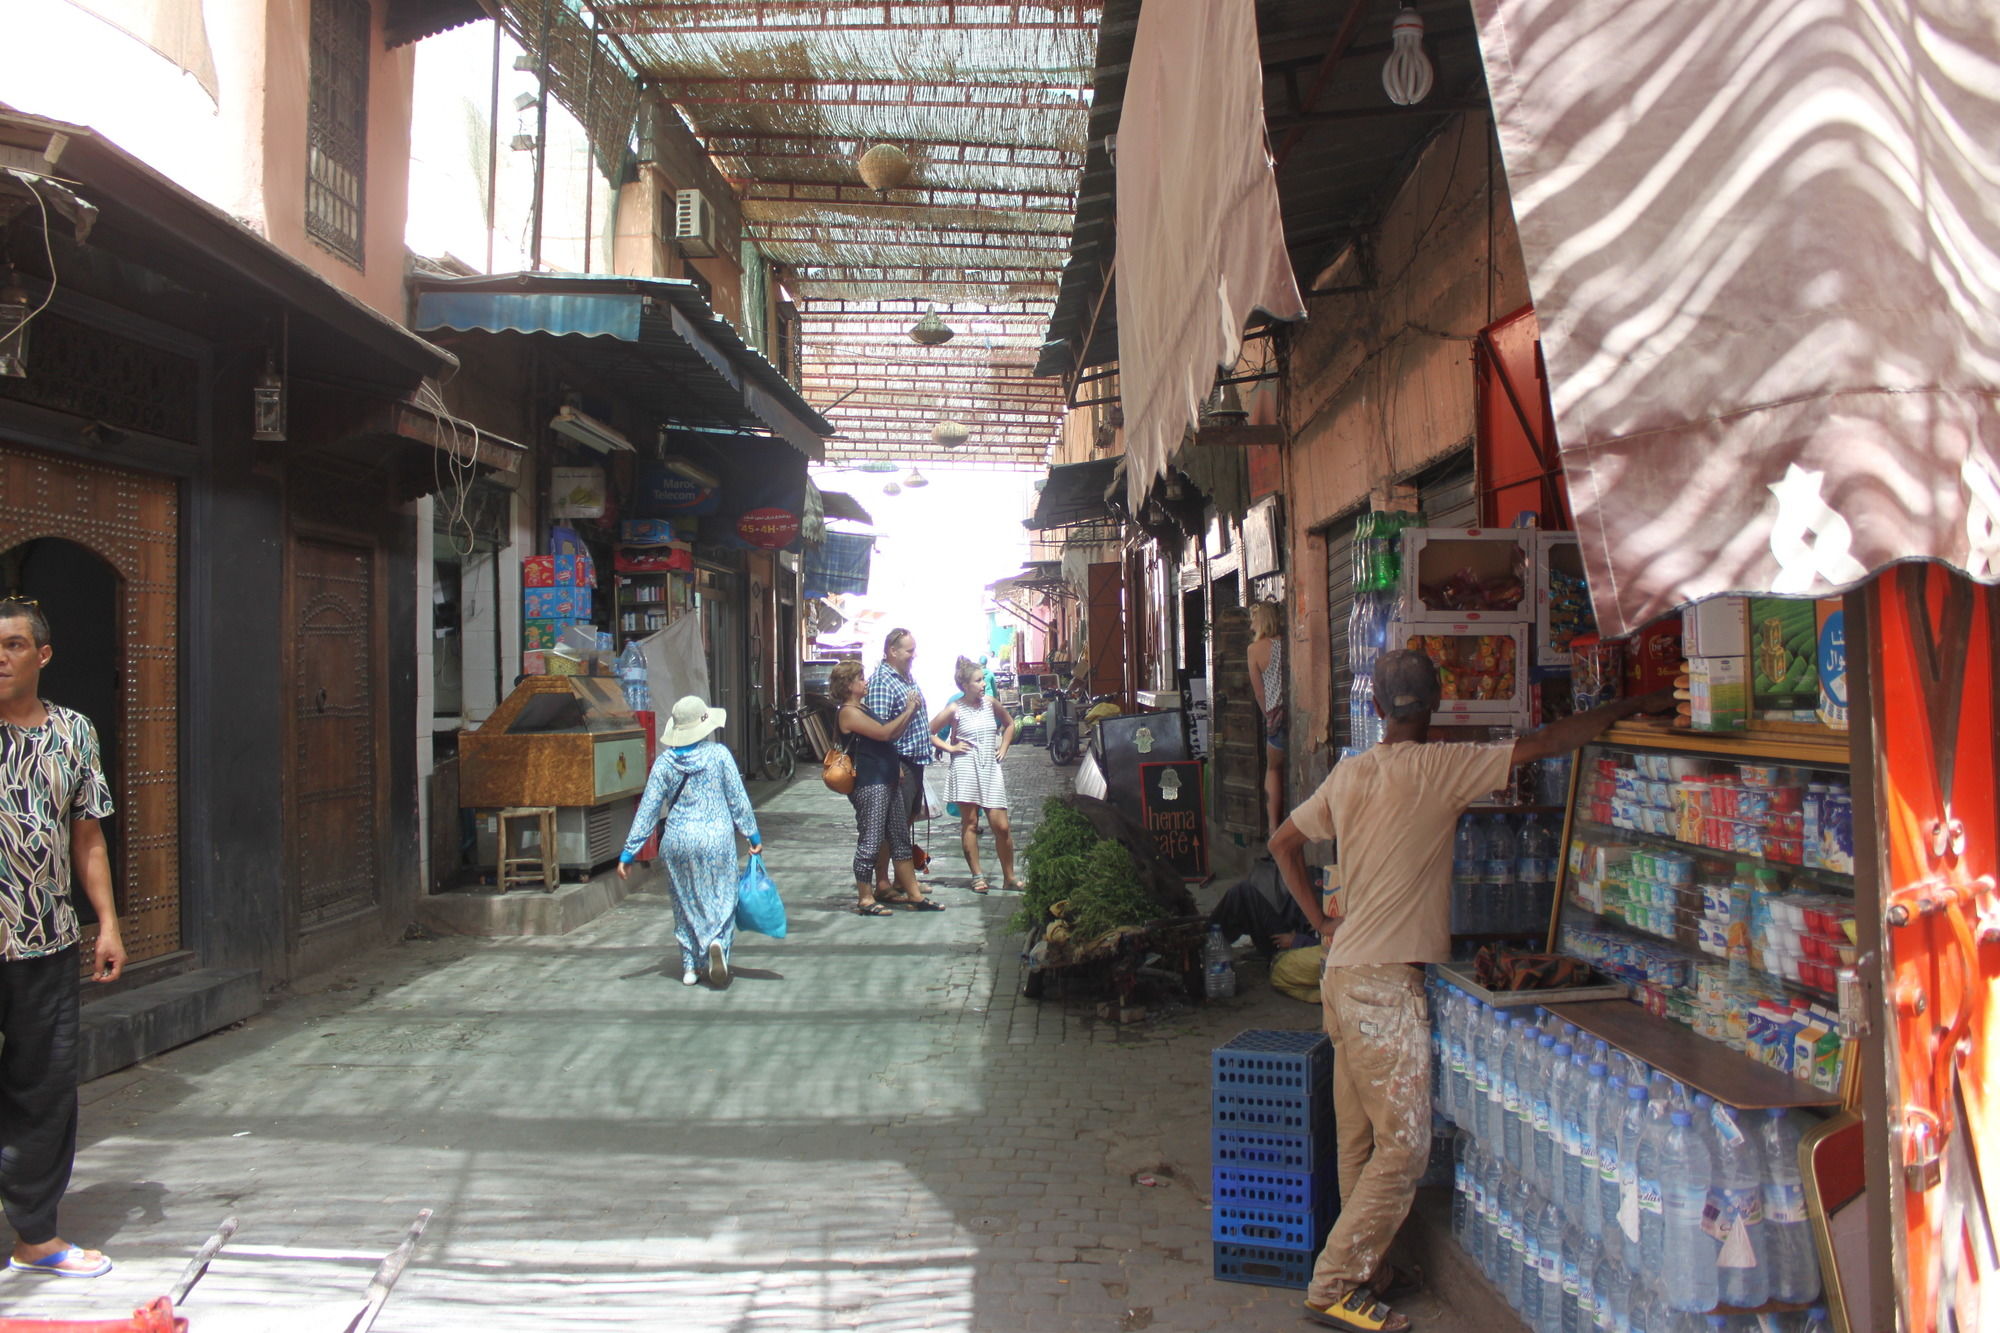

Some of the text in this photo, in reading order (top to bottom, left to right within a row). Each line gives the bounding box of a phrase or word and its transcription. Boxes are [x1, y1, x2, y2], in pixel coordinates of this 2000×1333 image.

[663, 478, 696, 489] Maroc
[654, 489, 697, 502] Telecom
[1830, 629, 1846, 646] نا
[1826, 649, 1846, 671] وال
[1148, 805, 1196, 831] henna
